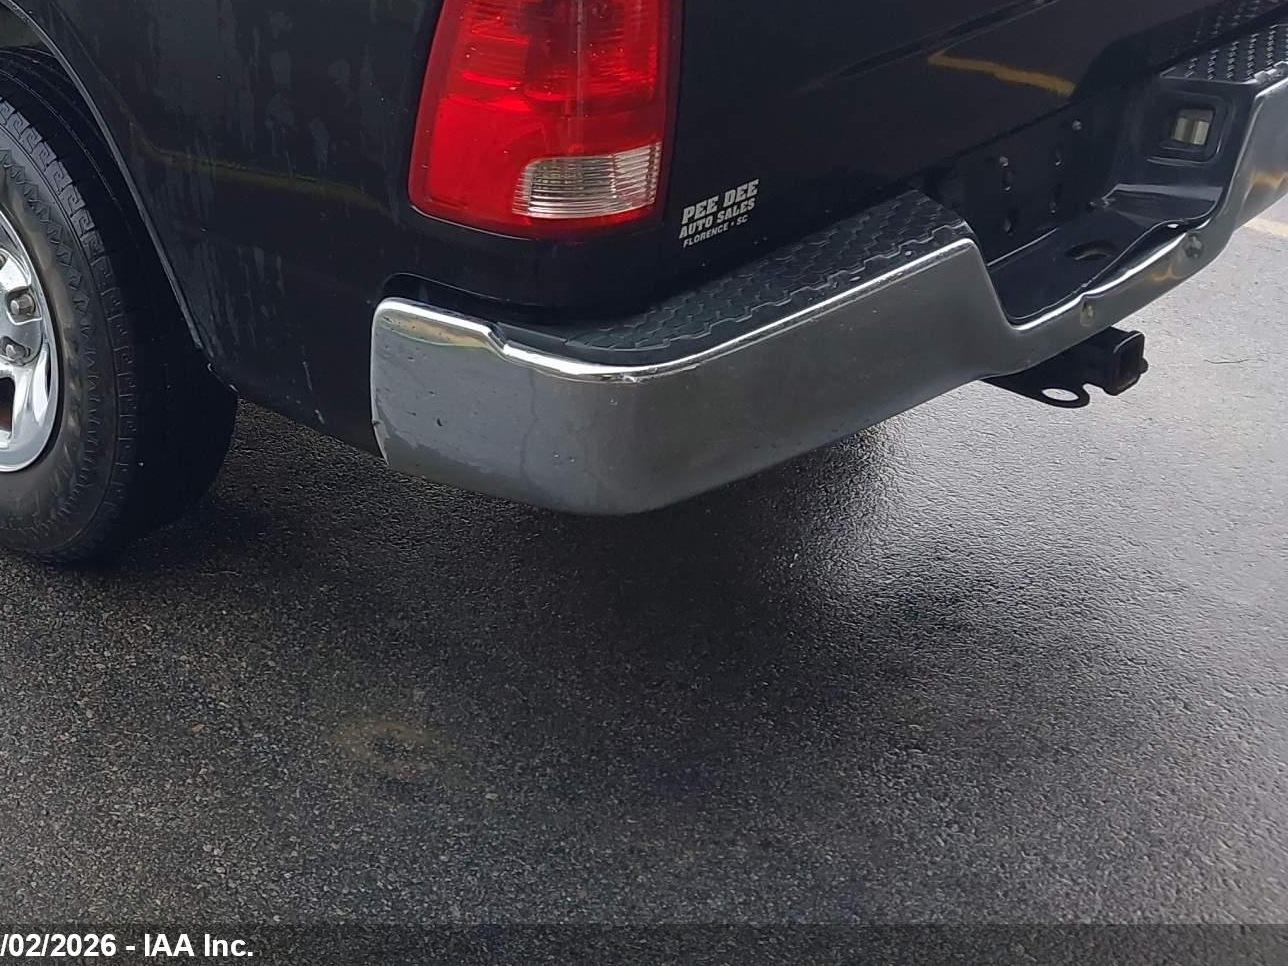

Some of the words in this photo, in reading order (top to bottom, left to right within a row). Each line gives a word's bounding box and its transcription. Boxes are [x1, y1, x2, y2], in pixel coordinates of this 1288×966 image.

[678, 215, 714, 240] AUTO
[716, 197, 756, 224] SALES
[681, 195, 720, 225] PEE
[722, 178, 760, 208] DEE
[682, 222, 729, 248] FLORENCE
[736, 214, 749, 226] SC
